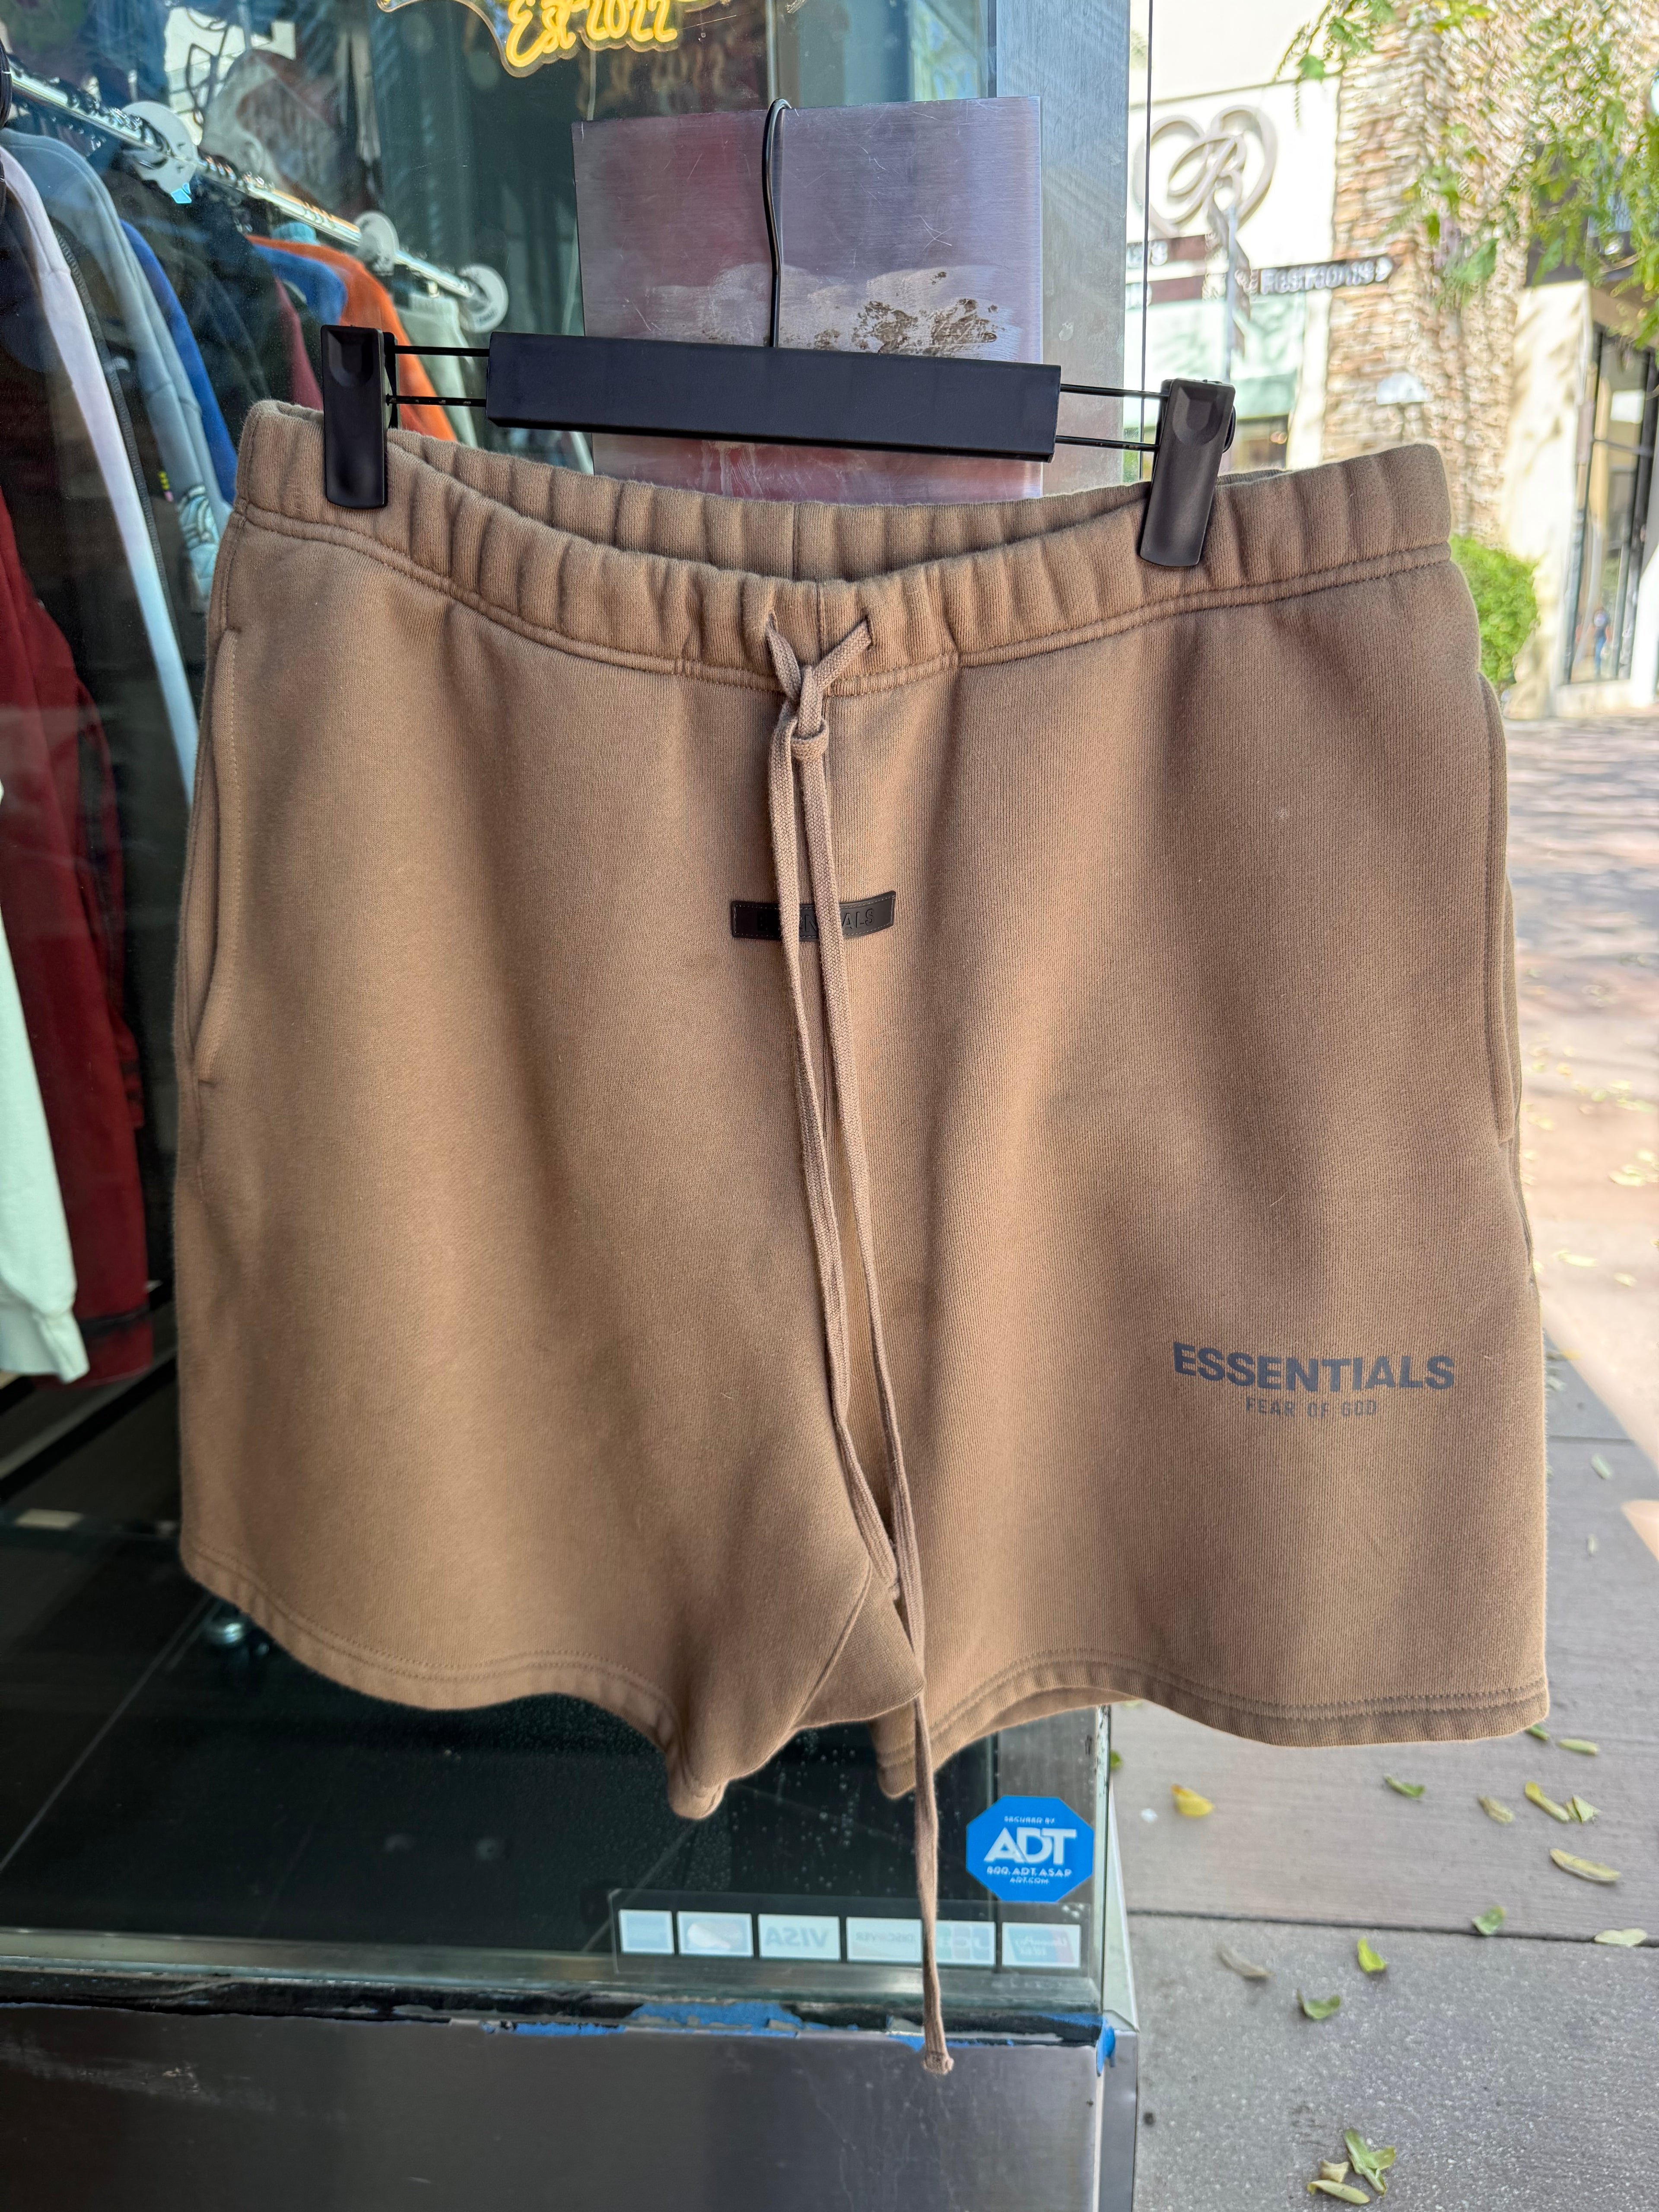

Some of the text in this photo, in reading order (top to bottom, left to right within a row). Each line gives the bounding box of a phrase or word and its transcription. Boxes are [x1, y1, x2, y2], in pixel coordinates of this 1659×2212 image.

[1173, 1341, 1455, 1392] ESSENTIALS
[1246, 1397, 1377, 1418] FEAR OF GOD
[983, 1826, 1077, 1866] ADT
